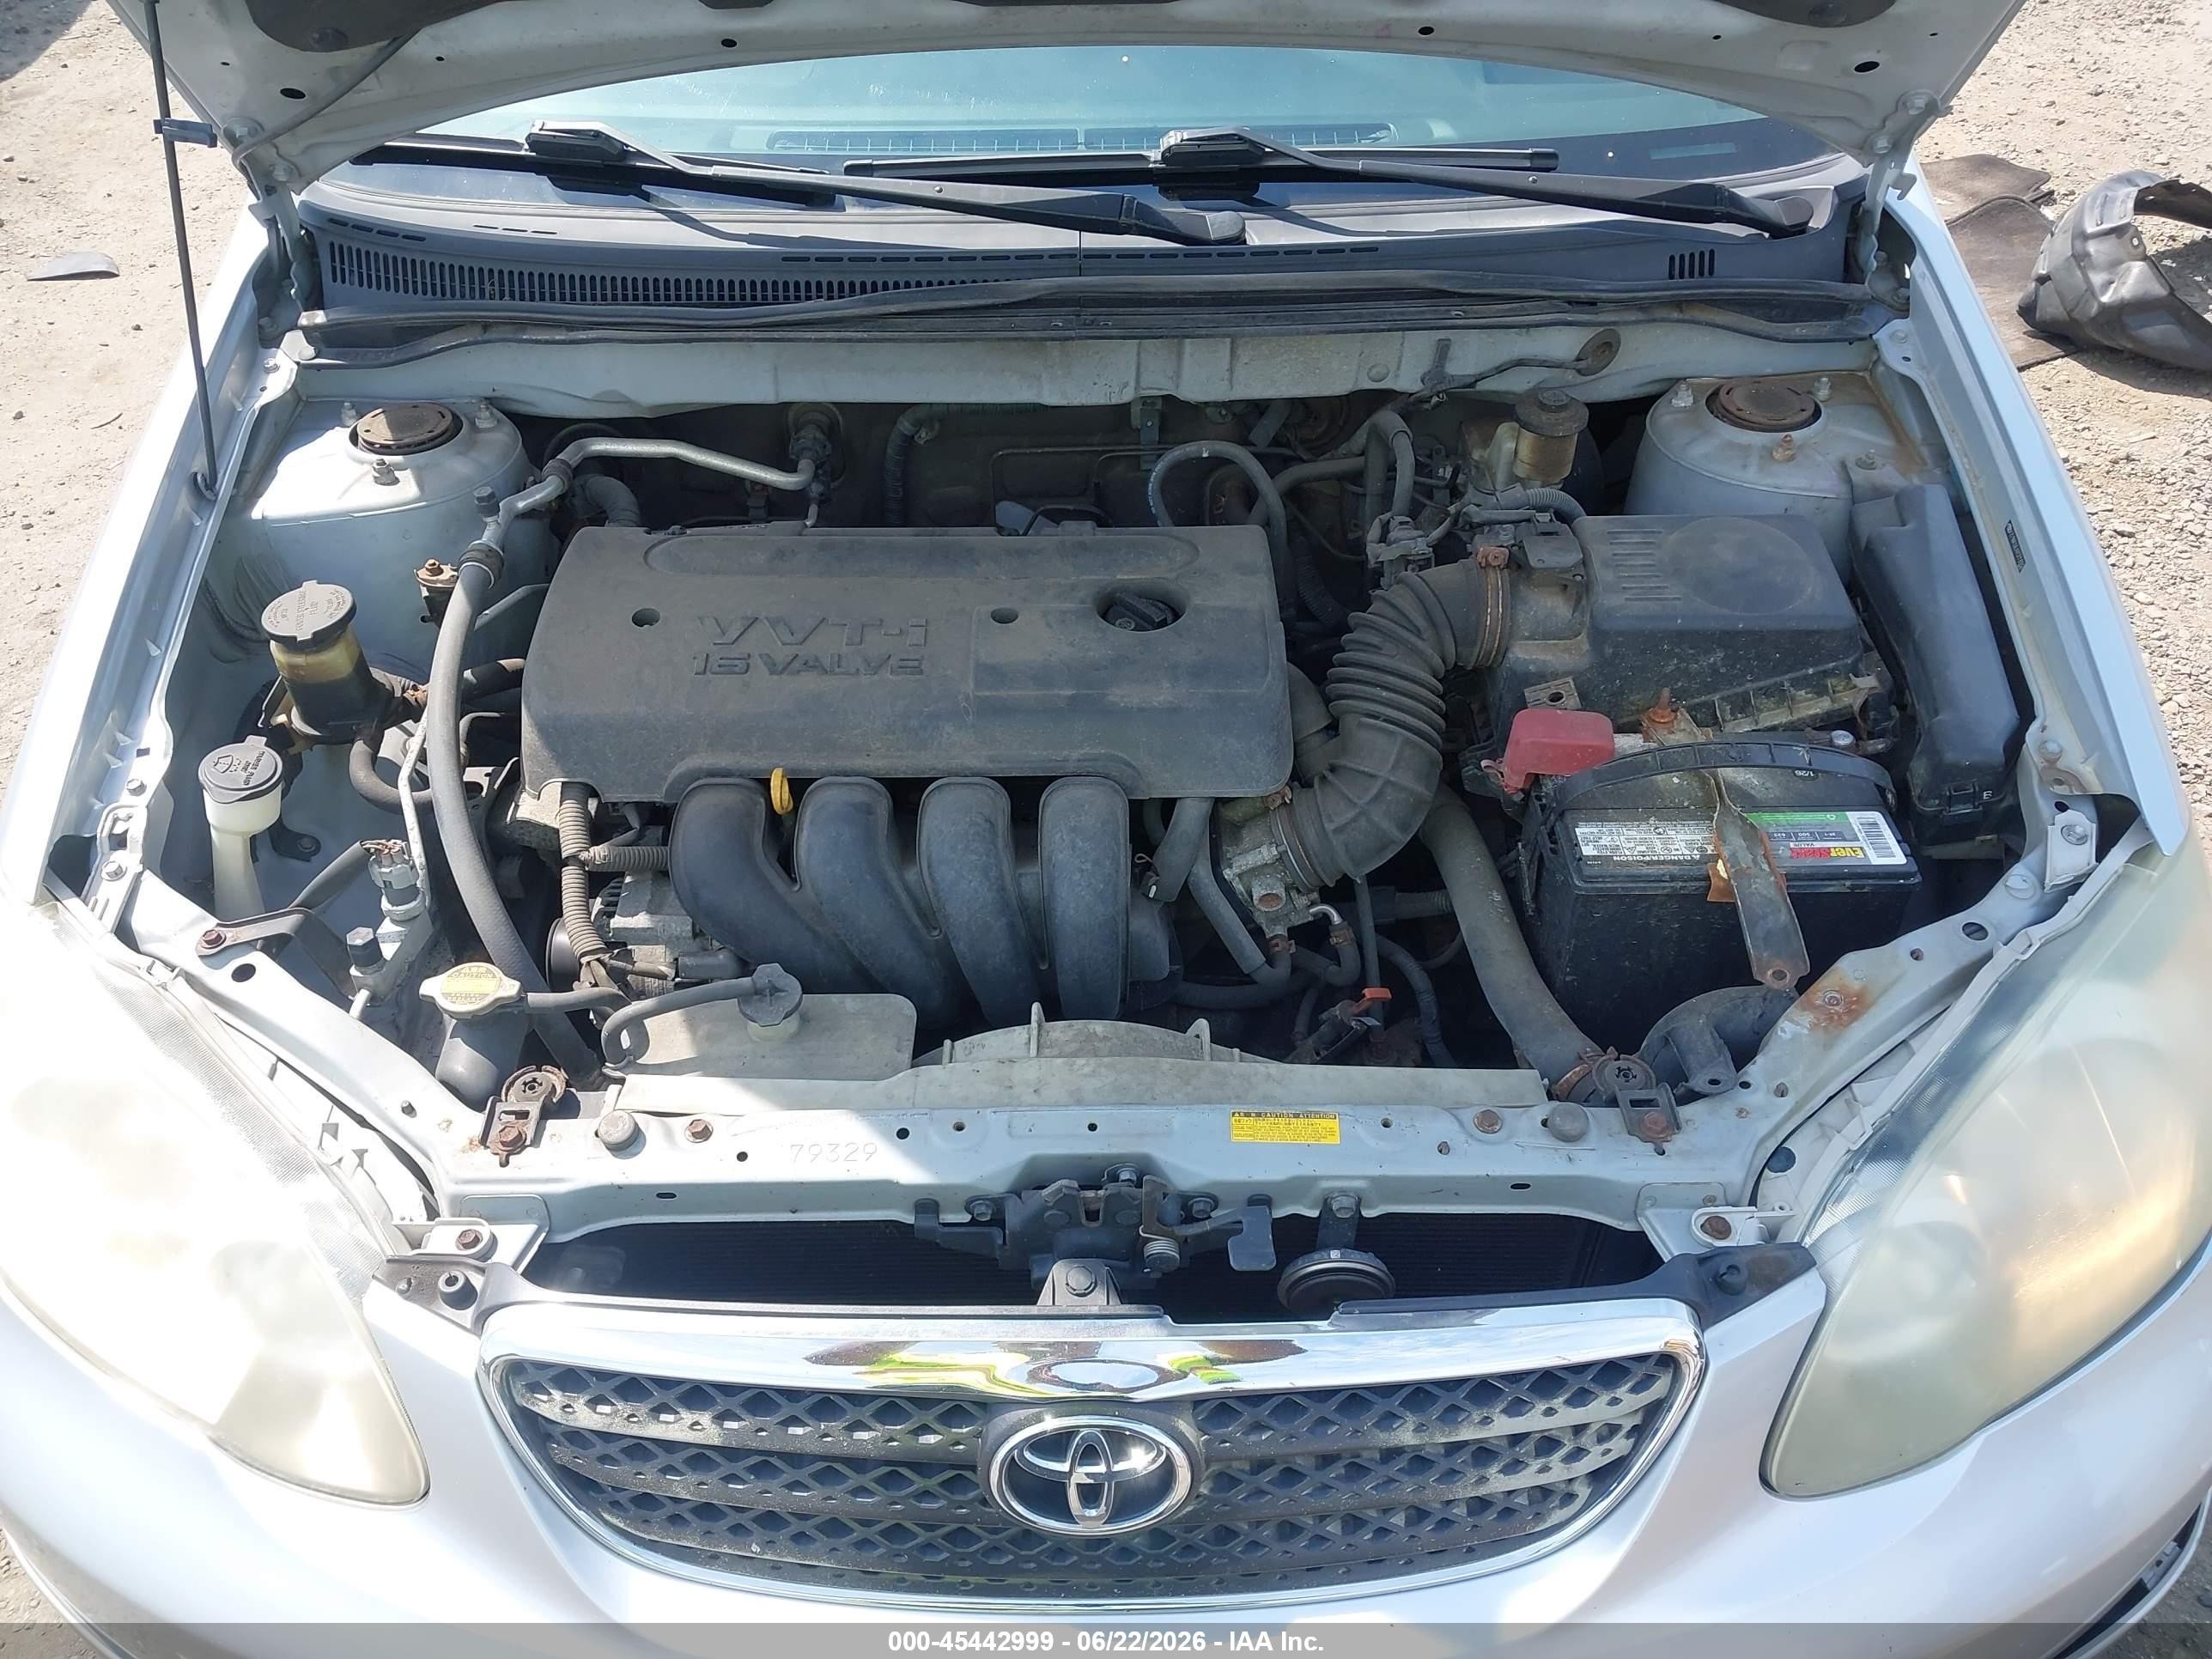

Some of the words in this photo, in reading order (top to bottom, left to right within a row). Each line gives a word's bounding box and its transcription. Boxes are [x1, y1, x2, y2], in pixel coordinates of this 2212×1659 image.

[692, 653, 751, 676] 16
[758, 653, 925, 676] VALVE
[1790, 847, 1866, 860] EverStart
[790, 1142, 878, 1163] 79329
